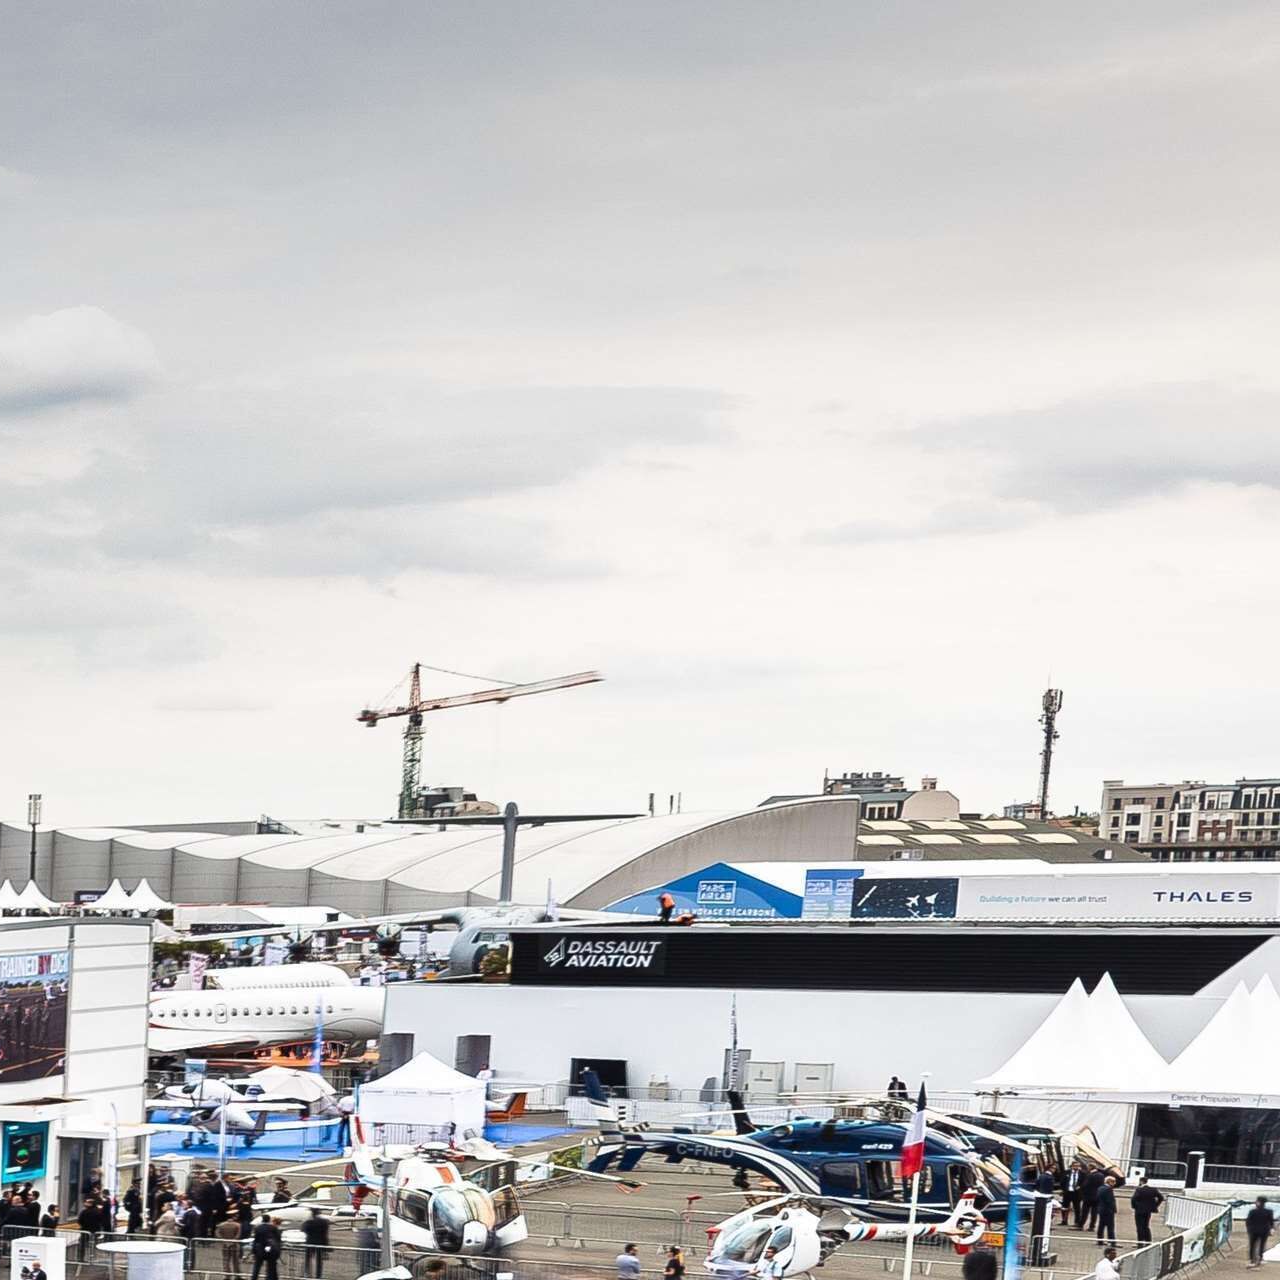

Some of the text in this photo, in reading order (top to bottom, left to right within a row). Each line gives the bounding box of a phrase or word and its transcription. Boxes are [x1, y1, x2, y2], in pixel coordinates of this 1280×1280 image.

[1153, 890, 1254, 903] THALES
[567, 941, 661, 954] DASSAULT
[565, 954, 653, 968] AVIATION
[1171, 1094, 1198, 1102] Electric
[676, 1143, 735, 1158] C-FNFO
